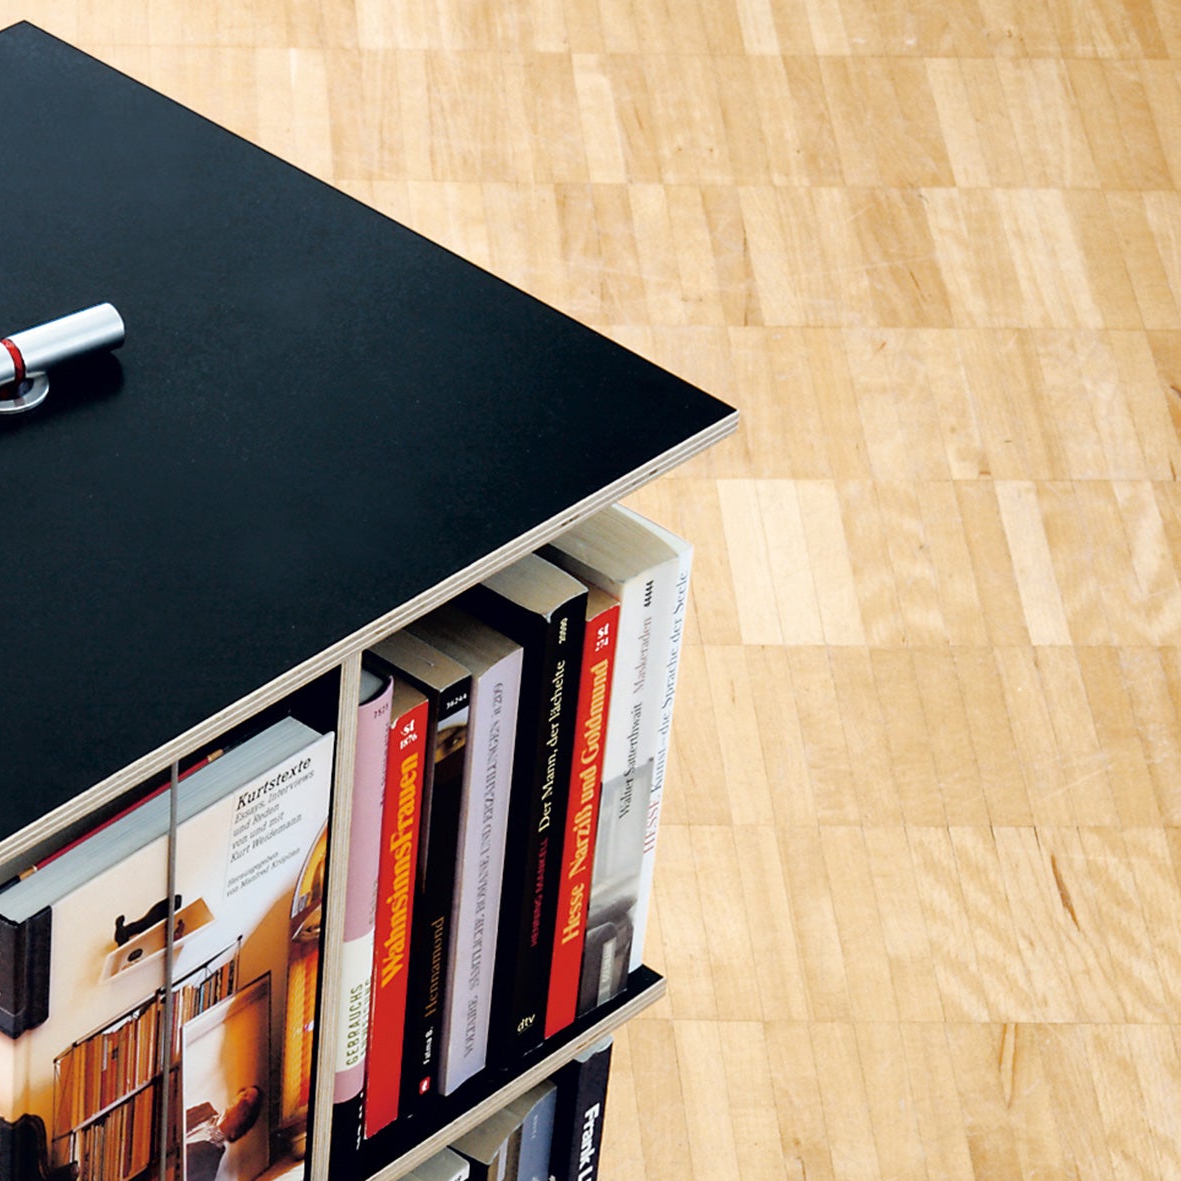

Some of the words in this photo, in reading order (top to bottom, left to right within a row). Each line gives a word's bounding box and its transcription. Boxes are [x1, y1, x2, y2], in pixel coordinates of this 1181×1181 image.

[672, 571, 689, 615] Seele
[632, 616, 653, 696] Maskeraden
[668, 618, 682, 644] der
[547, 659, 567, 720] lächelte
[580, 658, 609, 765] Goldmund
[546, 721, 560, 747] der
[622, 701, 643, 778] Satterthwait
[659, 711, 672, 736] die
[235, 757, 312, 811] Kurtstexte
[541, 747, 559, 801] Mann,
[579, 767, 598, 803] und
[616, 777, 635, 820] Walter
[538, 801, 552, 833] Der
[568, 804, 593, 880] Narziß
[380, 752, 419, 989] WahnsinnsFrauen
[562, 882, 585, 945] Hesse
[423, 915, 445, 1018] Hennamond
[346, 983, 364, 1066] GEBRAUCHS
[516, 1013, 536, 1032] dtv
[578, 1102, 601, 1171] Frank
